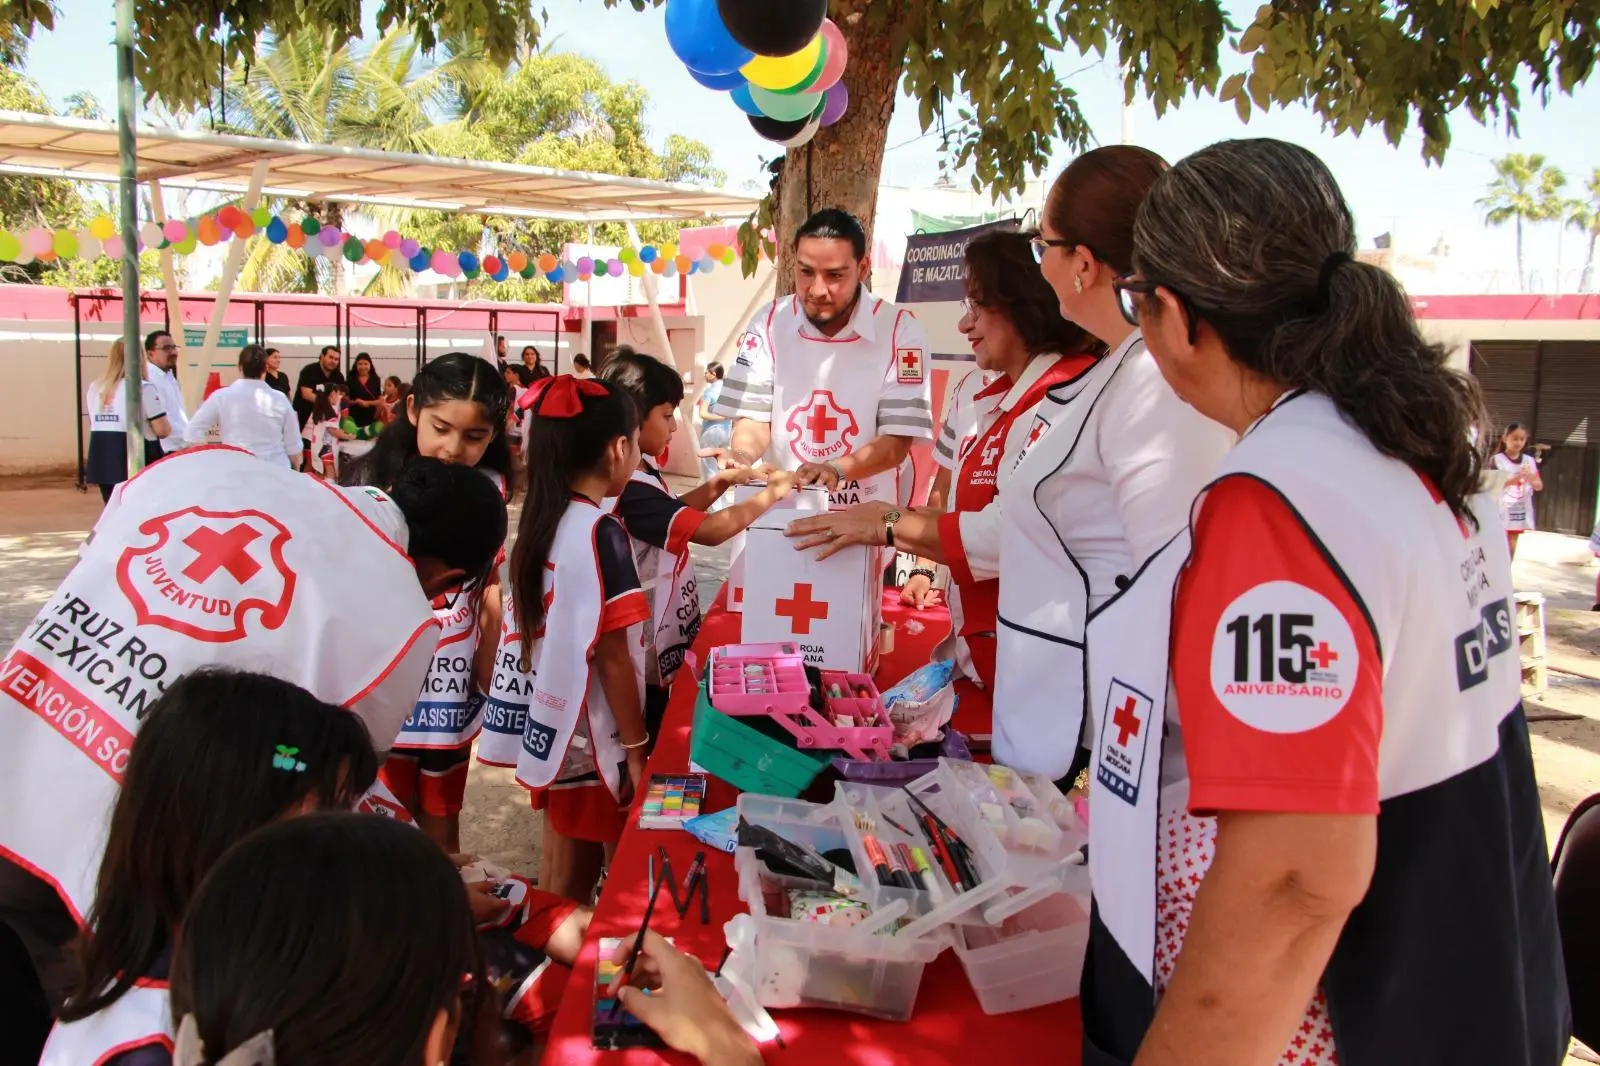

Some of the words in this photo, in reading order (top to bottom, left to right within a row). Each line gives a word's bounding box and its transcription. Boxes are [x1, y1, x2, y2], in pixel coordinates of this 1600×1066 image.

[907, 238, 970, 263] COORDINACI
[912, 267, 925, 283] DE
[925, 264, 970, 282] MAZATLA
[801, 440, 843, 457] JUVENTUD
[842, 480, 860, 490] JA
[828, 493, 861, 505] ANA
[145, 556, 232, 616] JUVENTUD
[800, 644, 824, 653] ROJA
[1226, 613, 1317, 684] 115
[660, 648, 686, 674] SERV
[803, 654, 824, 663] ANA
[29, 618, 158, 721] EXICAN
[1223, 684, 1343, 700] ANIVERSARIO
[0, 658, 103, 748] VENCIÓN
